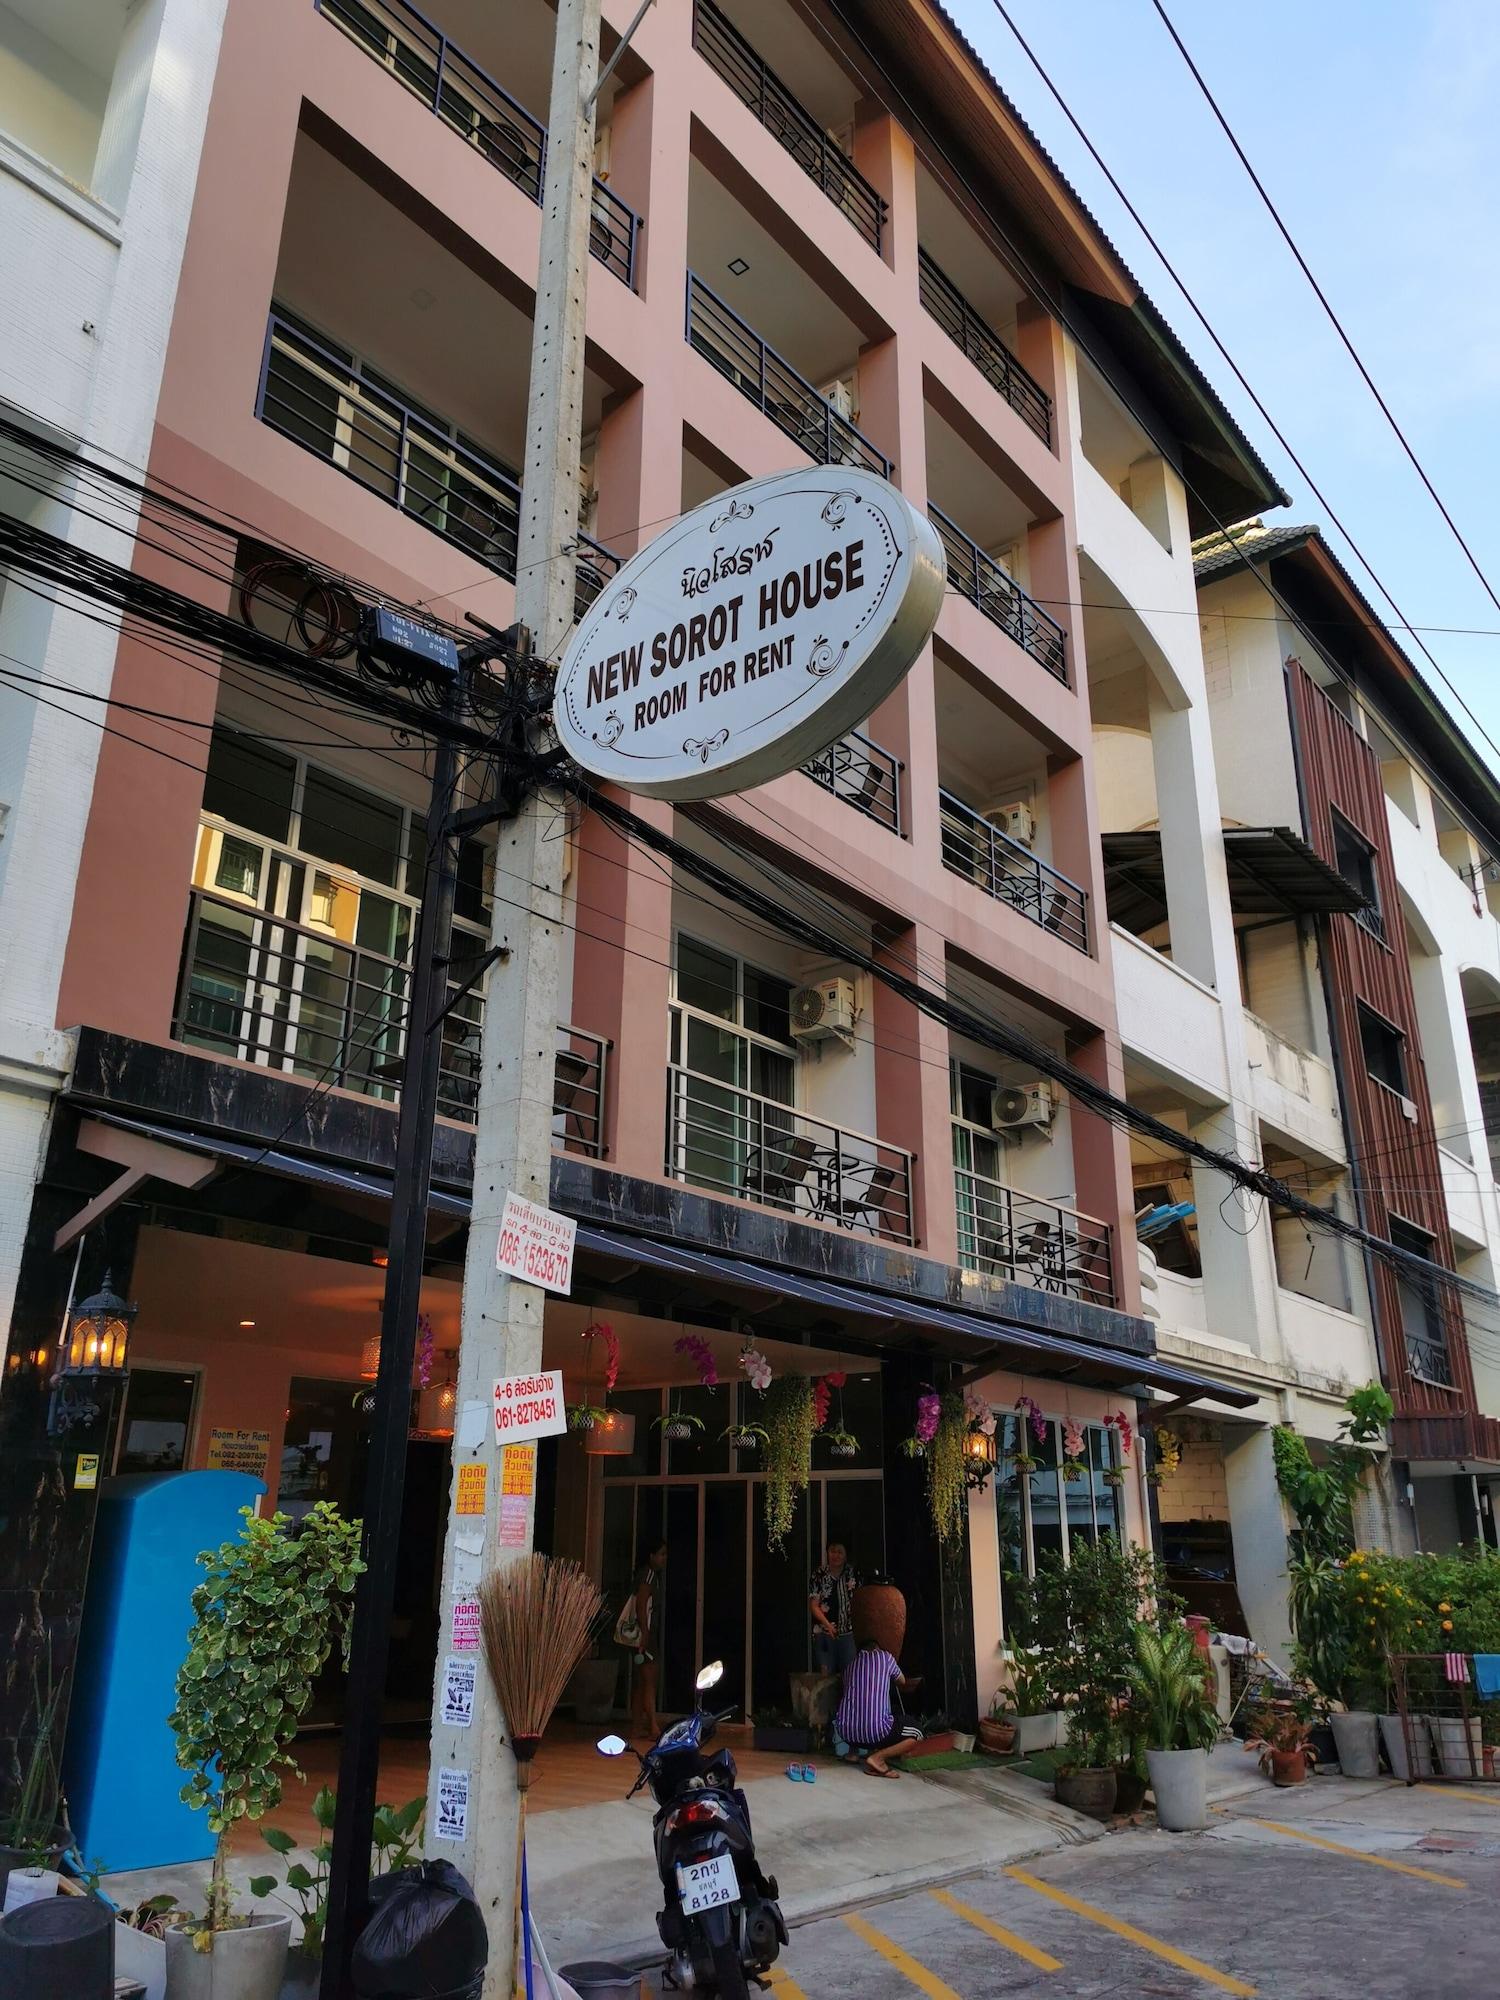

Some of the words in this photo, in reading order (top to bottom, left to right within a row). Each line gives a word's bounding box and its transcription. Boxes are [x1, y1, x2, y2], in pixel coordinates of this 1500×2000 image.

[586, 639, 645, 709] NEW
[649, 596, 744, 678] SOROT
[758, 539, 865, 632] HOUSE
[634, 682, 688, 732] ROOM
[698, 660, 737, 703] FOR
[744, 634, 796, 683] RENT
[520, 1224, 530, 1235] 4
[498, 1229, 569, 1287] 086-1523870
[495, 1383, 512, 1400] 4-6
[514, 1374, 554, 1397] ล้อรับจ้าง
[495, 1397, 556, 1430] 061-8278451
[212, 1429, 233, 1439] Room
[237, 1430, 250, 1440] For
[252, 1431, 270, 1442] Rent
[692, 1888, 730, 1909] 8128
